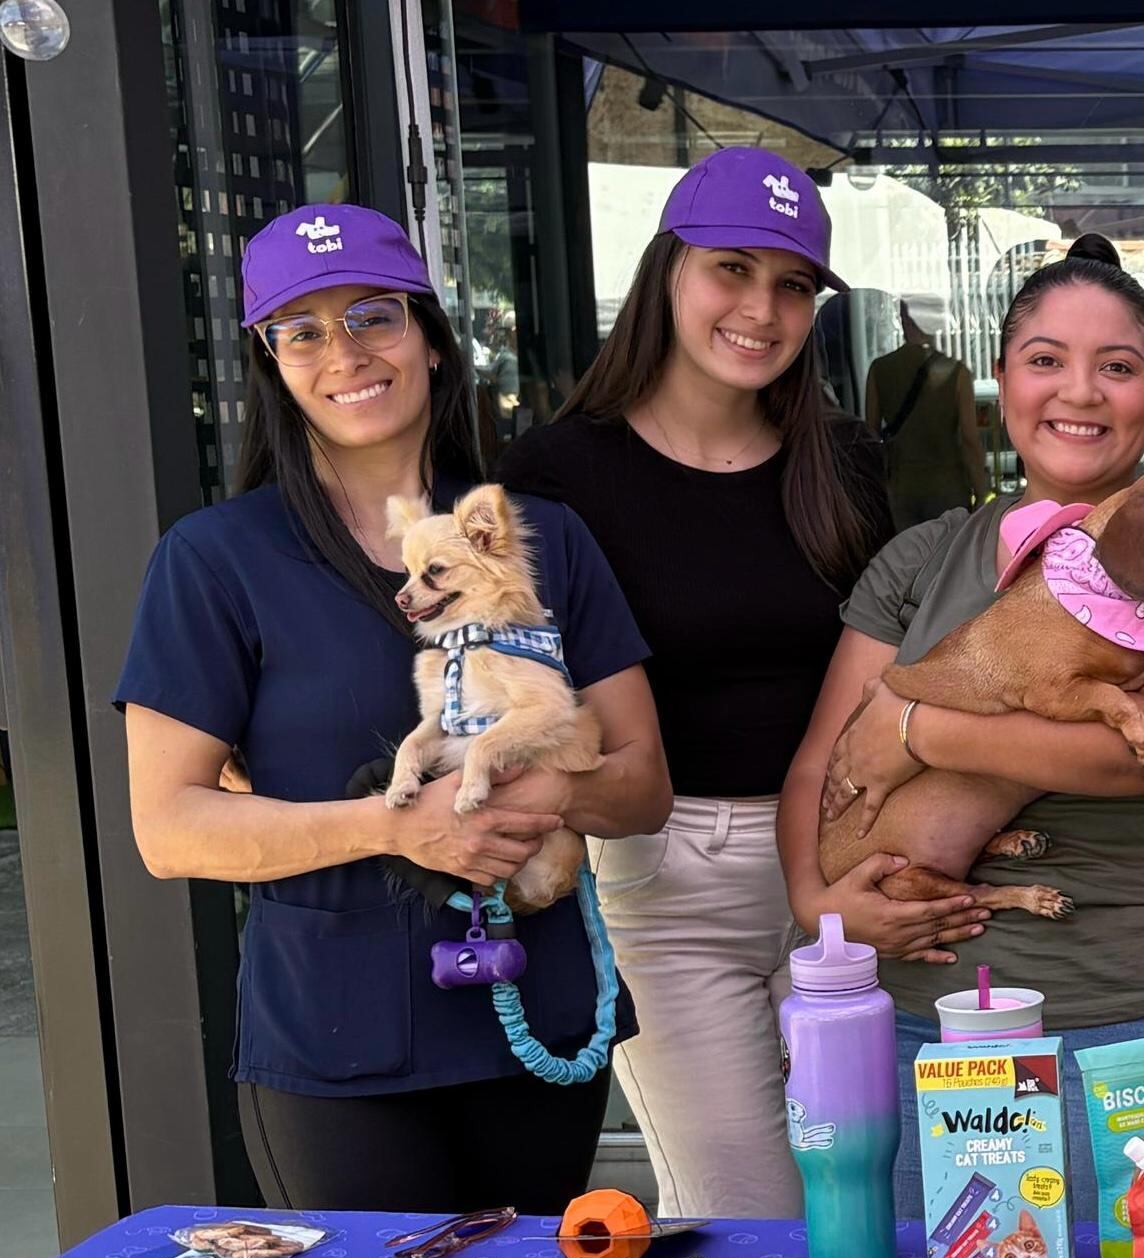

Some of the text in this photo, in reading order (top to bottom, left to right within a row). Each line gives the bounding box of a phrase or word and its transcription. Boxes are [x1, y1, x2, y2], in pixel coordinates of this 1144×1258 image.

[769, 196, 799, 219] tobi
[307, 237, 343, 254] tobi
[918, 1059, 1007, 1079] VALUE PACK
[966, 1138, 1013, 1152] CREAMY
[955, 1150, 1026, 1167] CAT TREATS
